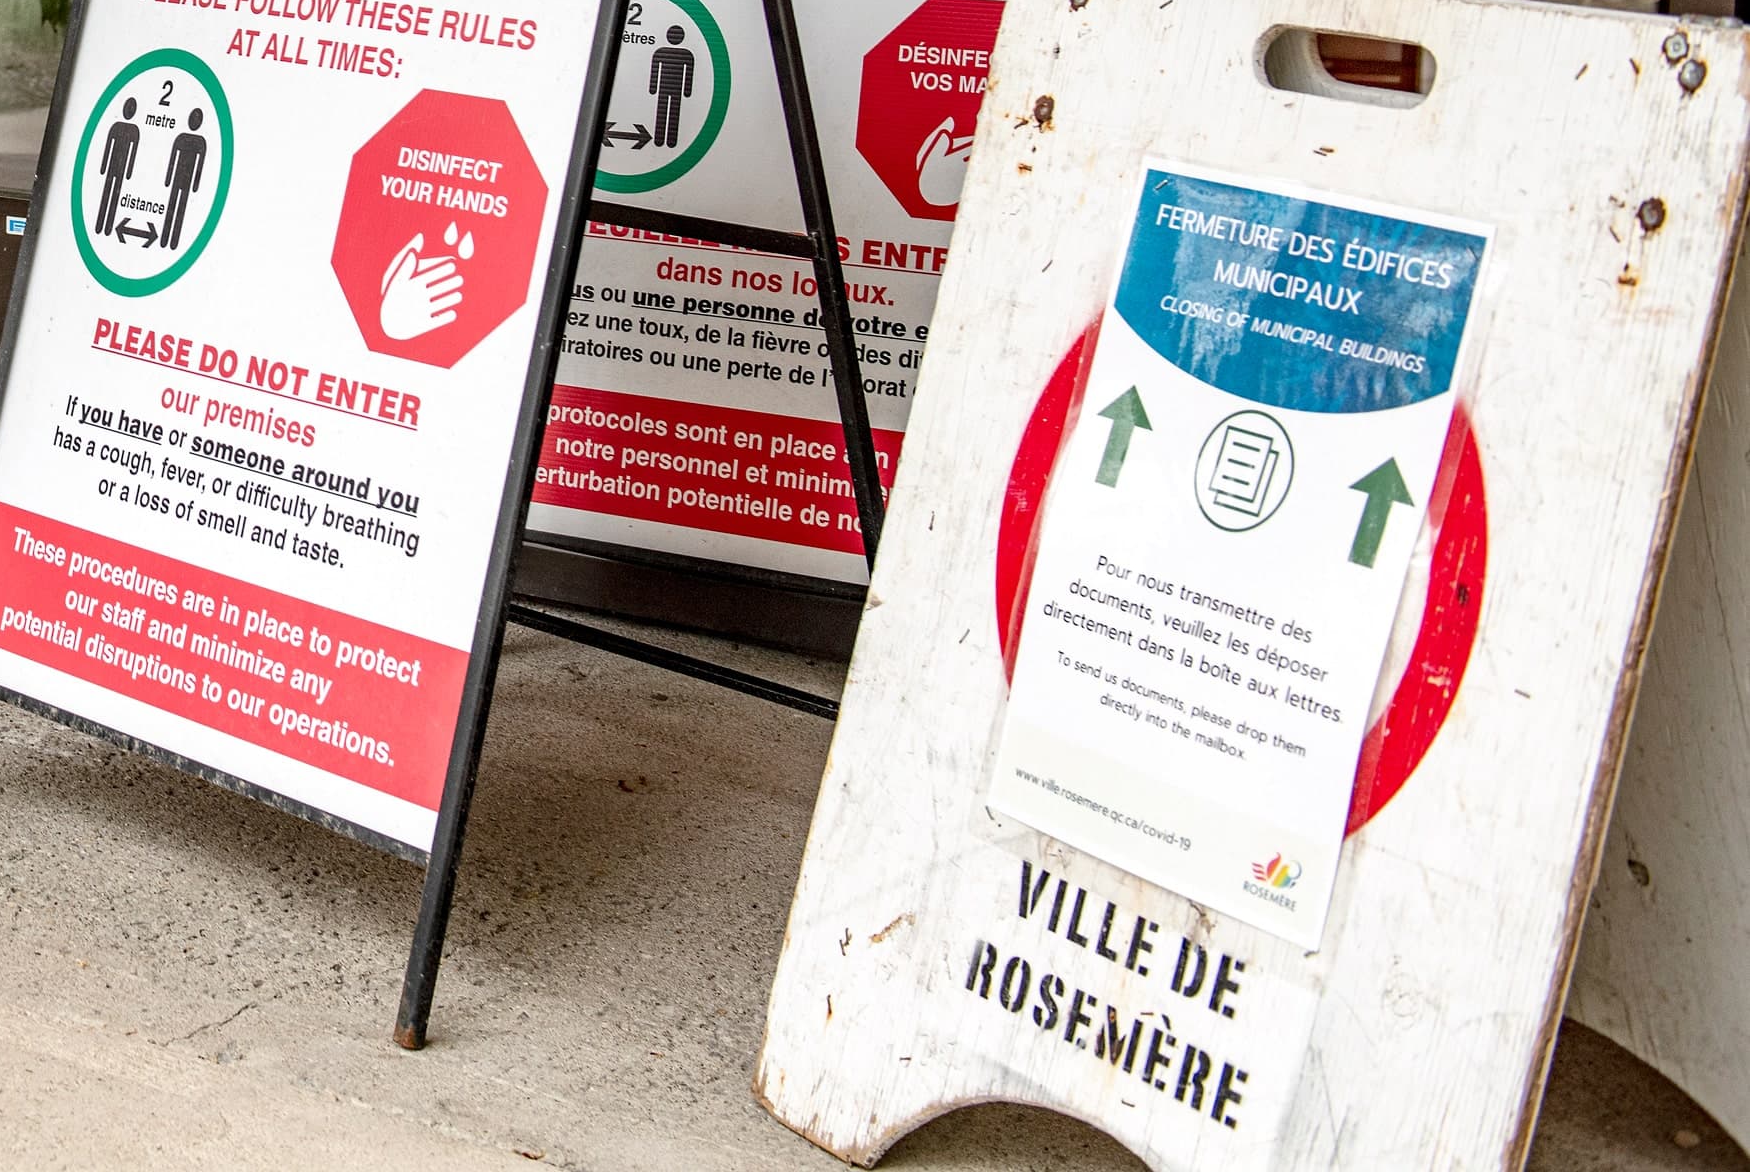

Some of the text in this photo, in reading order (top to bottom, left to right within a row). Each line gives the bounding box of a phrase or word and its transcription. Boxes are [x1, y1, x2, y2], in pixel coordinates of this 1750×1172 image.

[226, 28, 402, 78] AT ALL TIMES:
[439, 10, 536, 50] RULES
[158, 80, 173, 106] 2
[911, 72, 952, 91] VOS
[146, 114, 176, 128] metre
[398, 147, 502, 182] DISINFECT
[120, 192, 165, 215] distance
[382, 175, 508, 217] YOUR HANDS
[1156, 203, 1454, 289] FERMETURE DES ÉDIFICES
[657, 257, 782, 292] dans nos
[1213, 260, 1365, 315] MUNICIPAUX
[634, 292, 795, 324] une personne
[1160, 295, 1426, 373] CLOSING OF MUNICIPAL BUILDINGS
[94, 318, 420, 426] PLEASE DO NOT ENTER
[162, 388, 315, 447] our premises
[545, 404, 836, 460] protocoles sont place
[556, 438, 738, 480] notre personnel
[668, 487, 830, 527] potentielle de
[14, 526, 421, 686] These procedures are place protect
[1096, 556, 1312, 643] Pour nous transmettre des
[1070, 574, 1328, 682] documents, veuillez les déposer
[1044, 600, 1345, 724] directement dans la boîte aux lettres.
[1058, 650, 1306, 756] To send us documents, please drop them
[1100, 694, 1247, 760] directly into the mailbox.
[1016, 768, 1191, 853] www.ville.rosemere.qc.ca/covid-19
[1243, 880, 1296, 912] ROSEMÈRE
[1019, 860, 1246, 1019] VILLE DE
[966, 941, 1248, 1129] ROSEMÈRE
